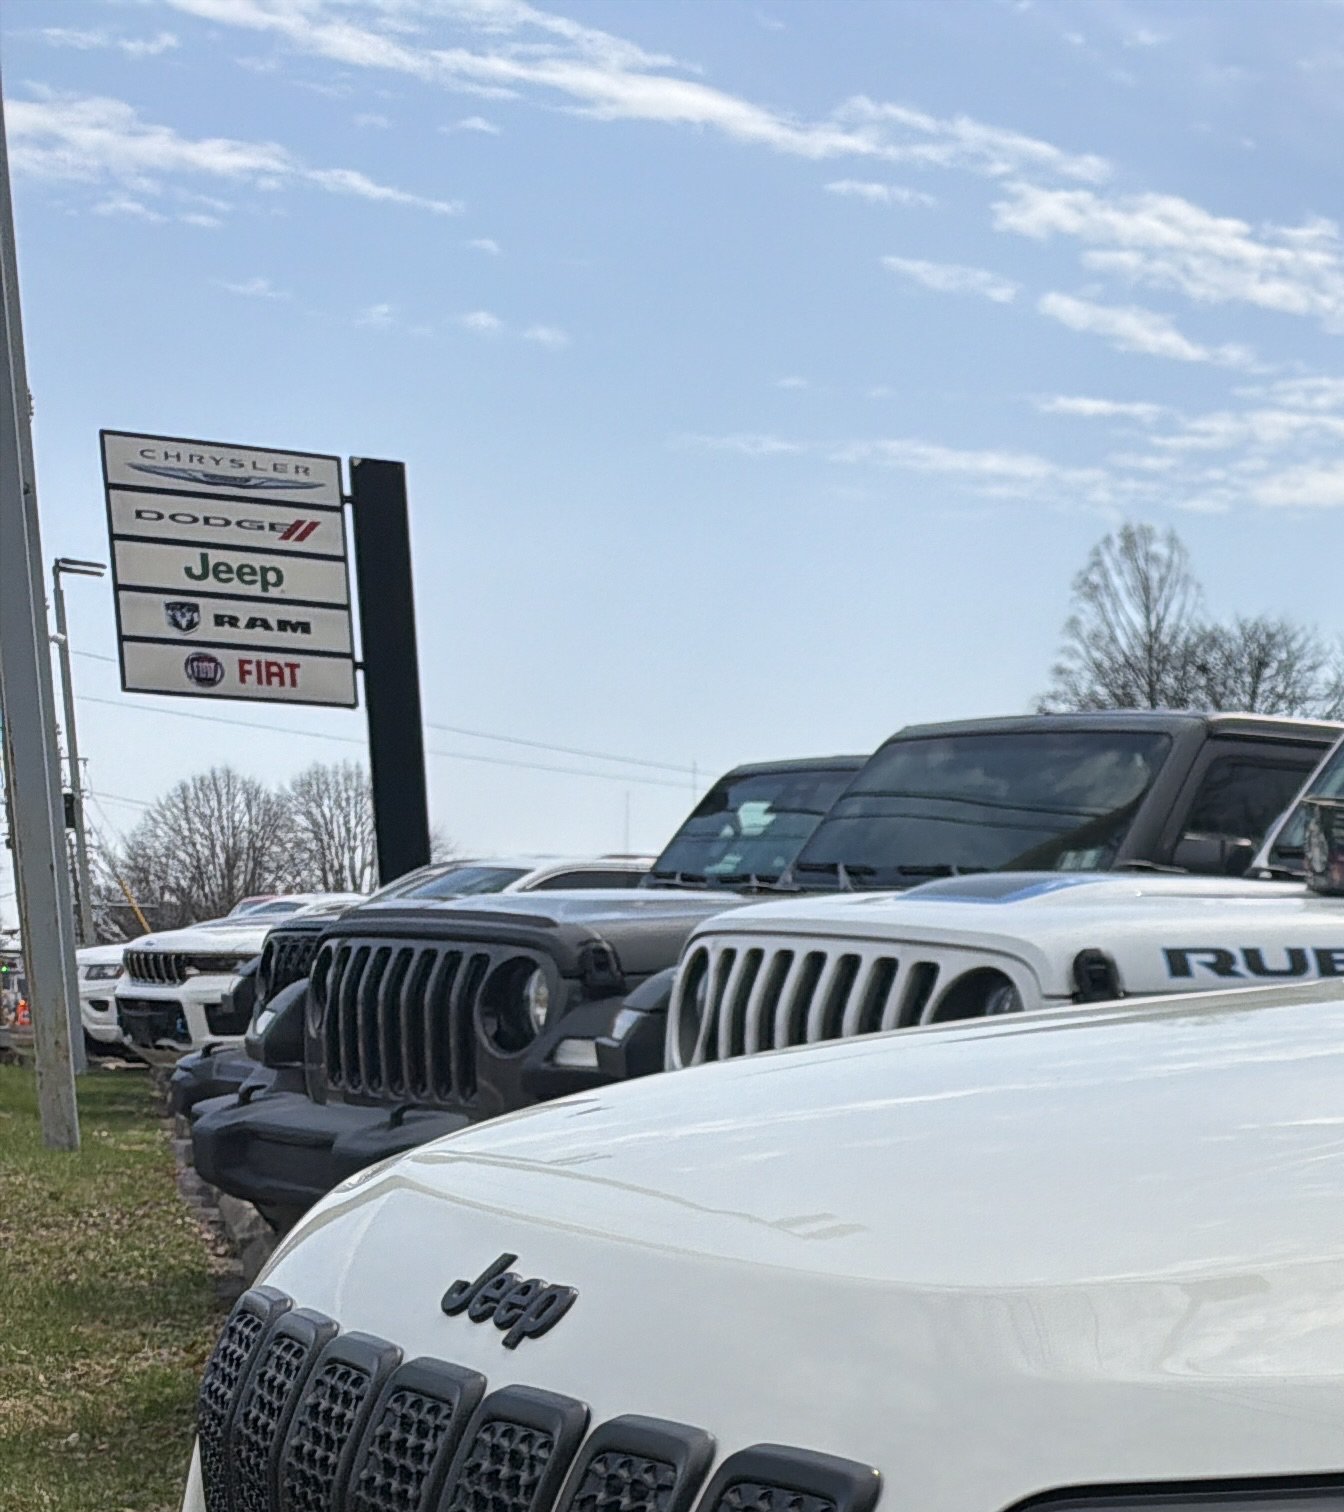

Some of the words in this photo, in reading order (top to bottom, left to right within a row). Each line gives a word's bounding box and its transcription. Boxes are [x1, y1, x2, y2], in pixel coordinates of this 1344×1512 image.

[139, 448, 311, 477] CHRYSLER
[134, 508, 297, 534] DODGE
[184, 552, 284, 593] Jeep
[213, 613, 312, 635] RAM
[237, 658, 301, 689] FIAT
[440, 1252, 580, 1350] Jeep
